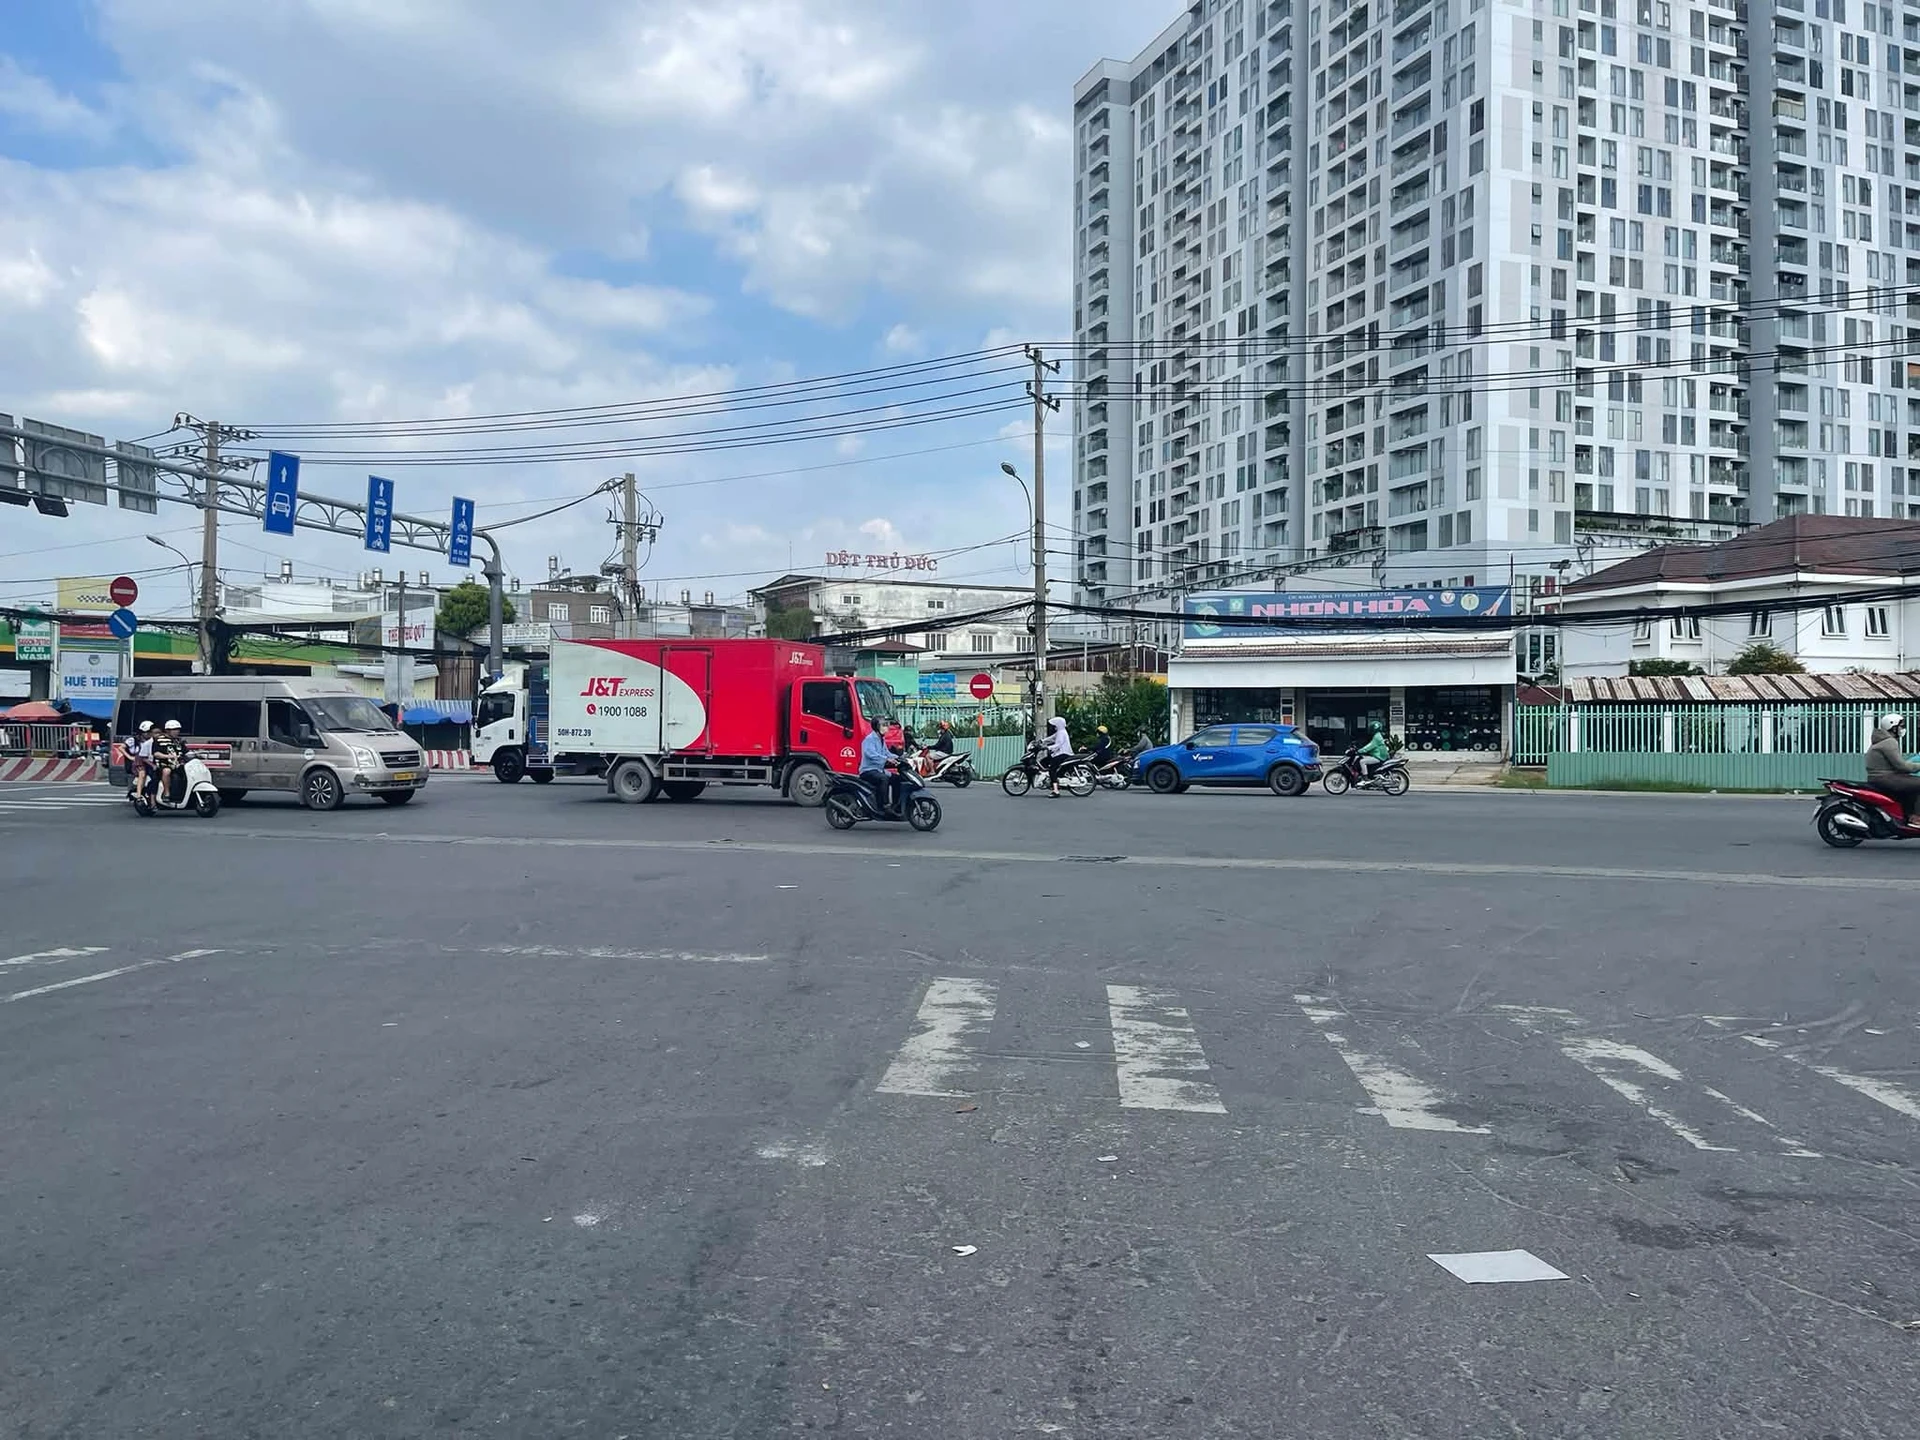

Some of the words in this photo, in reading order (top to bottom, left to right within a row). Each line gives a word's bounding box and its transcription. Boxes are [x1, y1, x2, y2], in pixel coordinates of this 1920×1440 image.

[826, 550, 861, 568] DỆT
[866, 552, 900, 569] THỦ
[905, 554, 938, 571] ĐỨC
[1252, 600, 1349, 616] NHƠN
[64, 675, 87, 689] HUỆ
[580, 677, 628, 697] J&T
[619, 688, 655, 697] EXPRESS
[598, 706, 622, 717] 1900
[624, 706, 648, 717] 1088
